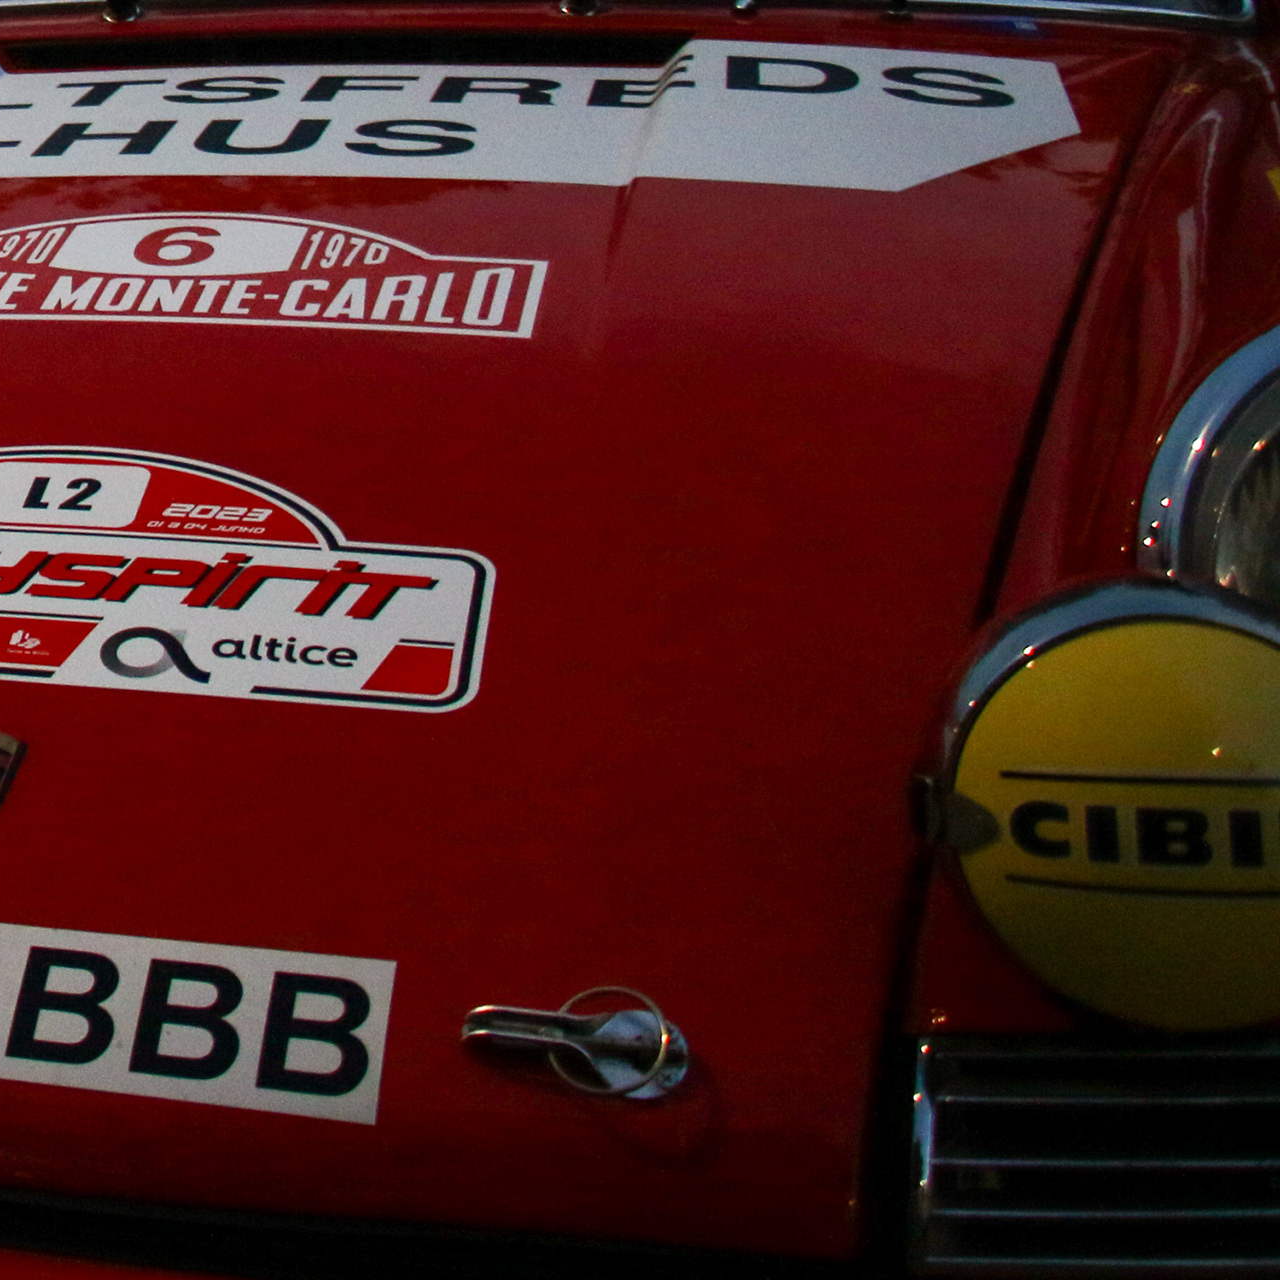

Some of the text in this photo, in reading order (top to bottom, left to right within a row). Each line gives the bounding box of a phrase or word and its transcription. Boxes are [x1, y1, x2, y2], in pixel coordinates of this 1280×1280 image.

[132, 225, 222, 267] 6
[299, 229, 391, 271] 1970
[39, 266, 516, 327] MONTE-CARLO
[161, 502, 274, 523] 2023
[209, 523, 267, 535] JUNHO
[211, 631, 359, 671] altice
[1008, 799, 1280, 869] CIBI
[3, 944, 374, 1099] BBB
